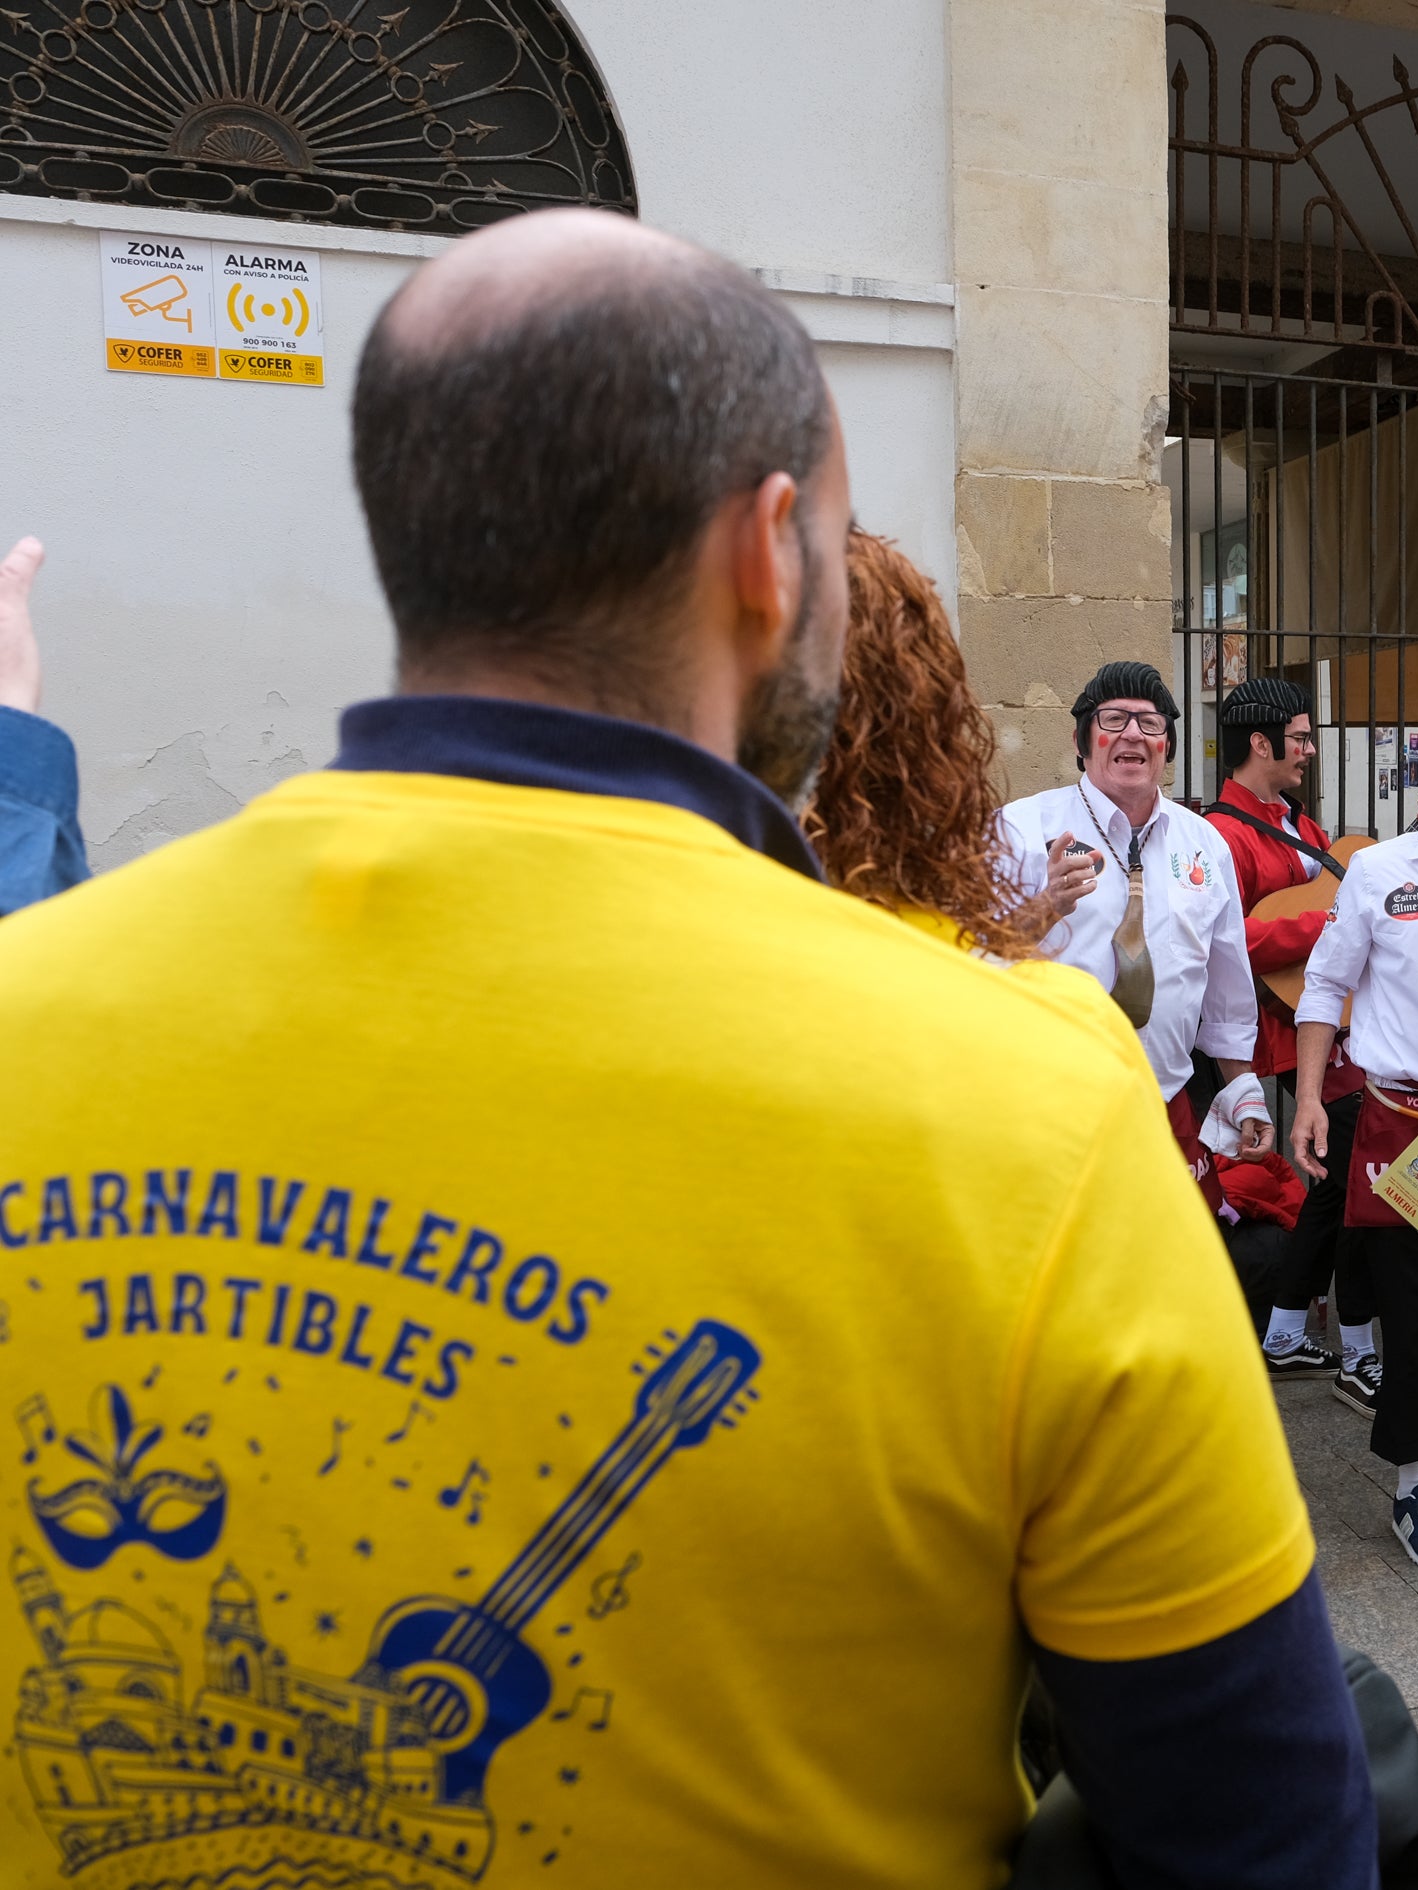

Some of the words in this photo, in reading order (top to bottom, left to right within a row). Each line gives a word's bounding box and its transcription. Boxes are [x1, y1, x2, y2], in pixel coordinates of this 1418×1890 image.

[127, 241, 185, 260] ZONA
[110, 256, 184, 270] VIDEOVIGILADA
[185, 263, 204, 272] 24H
[225, 254, 307, 273] ALARMA
[223, 268, 241, 276] CON
[243, 270, 268, 278] AVISO
[277, 273, 310, 282] POLICÍA
[242, 337, 260, 346] 900
[261, 339, 278, 347] 900
[281, 341, 297, 349] 163
[137, 346, 183, 361] COFER
[138, 358, 184, 369] SEGURIDAD
[248, 356, 292, 371] COFER
[249, 368, 293, 379] SEGURIDAD
[1384, 1186, 1418, 1218] ALMERÍA
[0, 1168, 609, 1345] CARNAVALEROS
[78, 1272, 475, 1400] JARTIBLES
